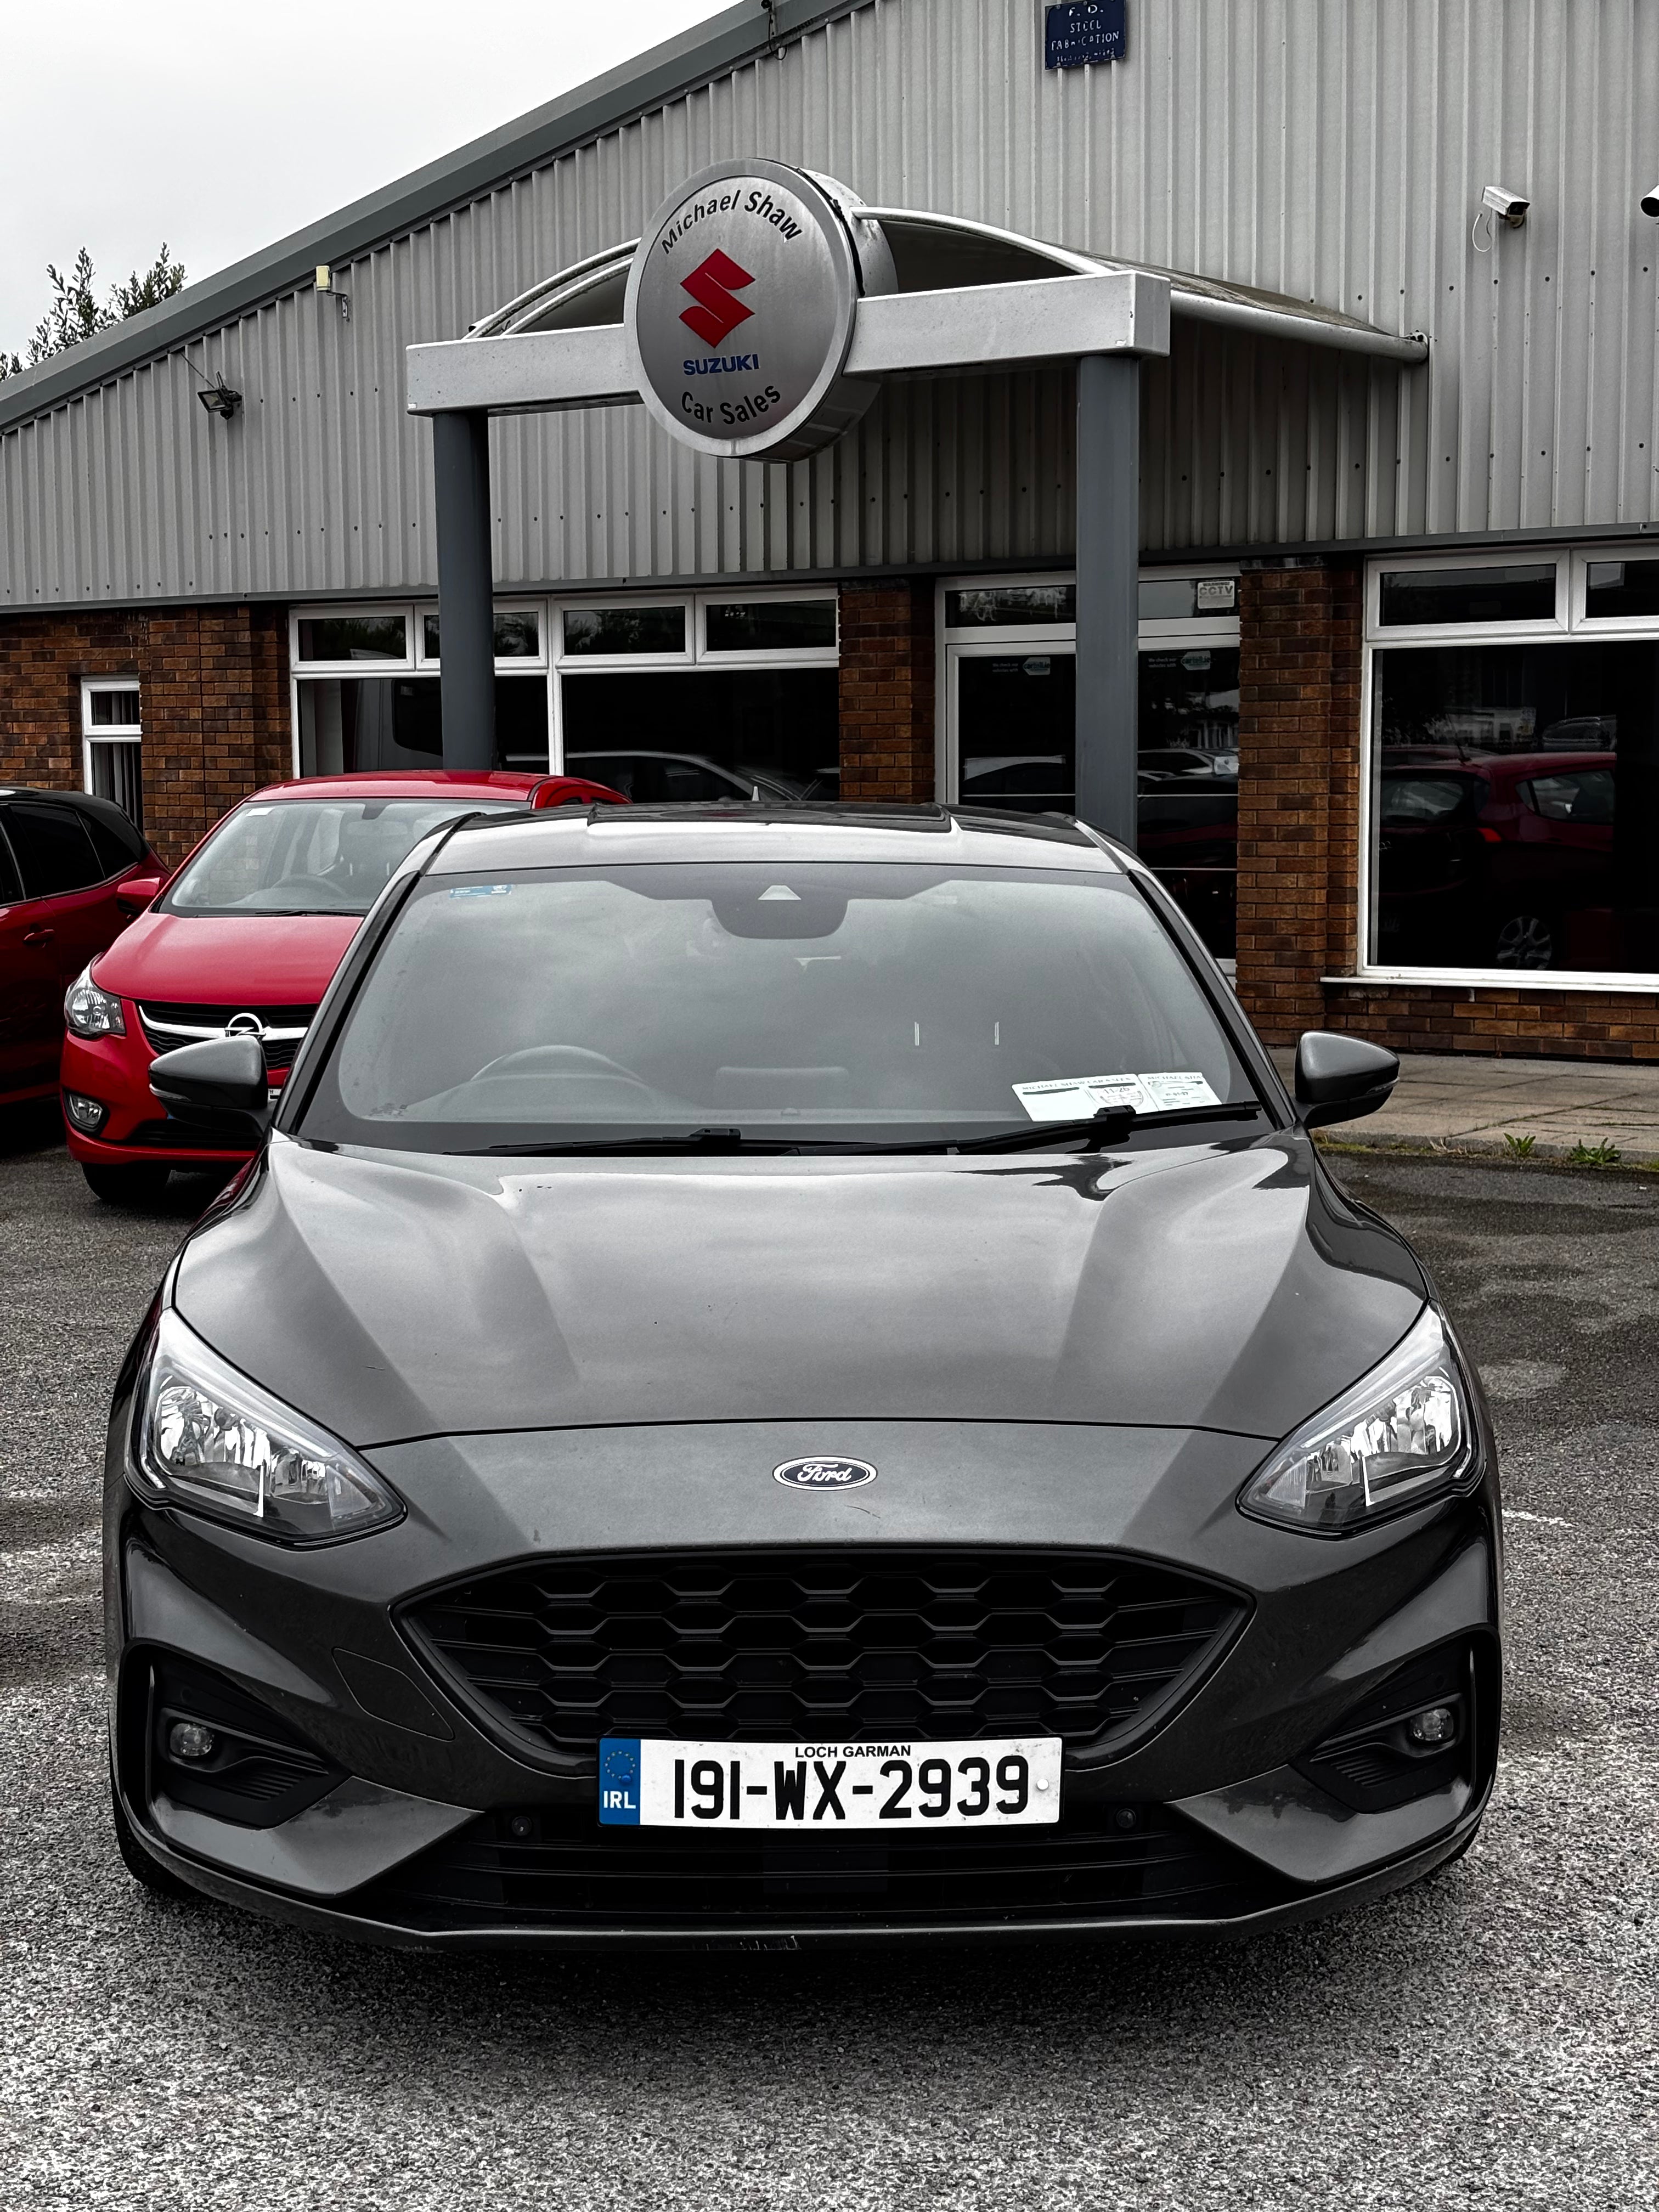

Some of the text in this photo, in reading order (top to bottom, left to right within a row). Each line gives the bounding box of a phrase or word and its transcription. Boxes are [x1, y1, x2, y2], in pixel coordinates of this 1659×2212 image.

[1070, 20, 1102, 33] STEEL
[661, 189, 803, 255] Michael Shaw
[684, 354, 760, 376] SUZUKI
[681, 385, 781, 425] Car Sales
[1199, 585, 1233, 595] CCTV
[797, 1464, 853, 1482] Ford
[795, 1745, 911, 1758] LOCH GARMAN
[674, 1756, 1029, 1820] 191-WX-2939
[603, 1791, 636, 1809] IRL
